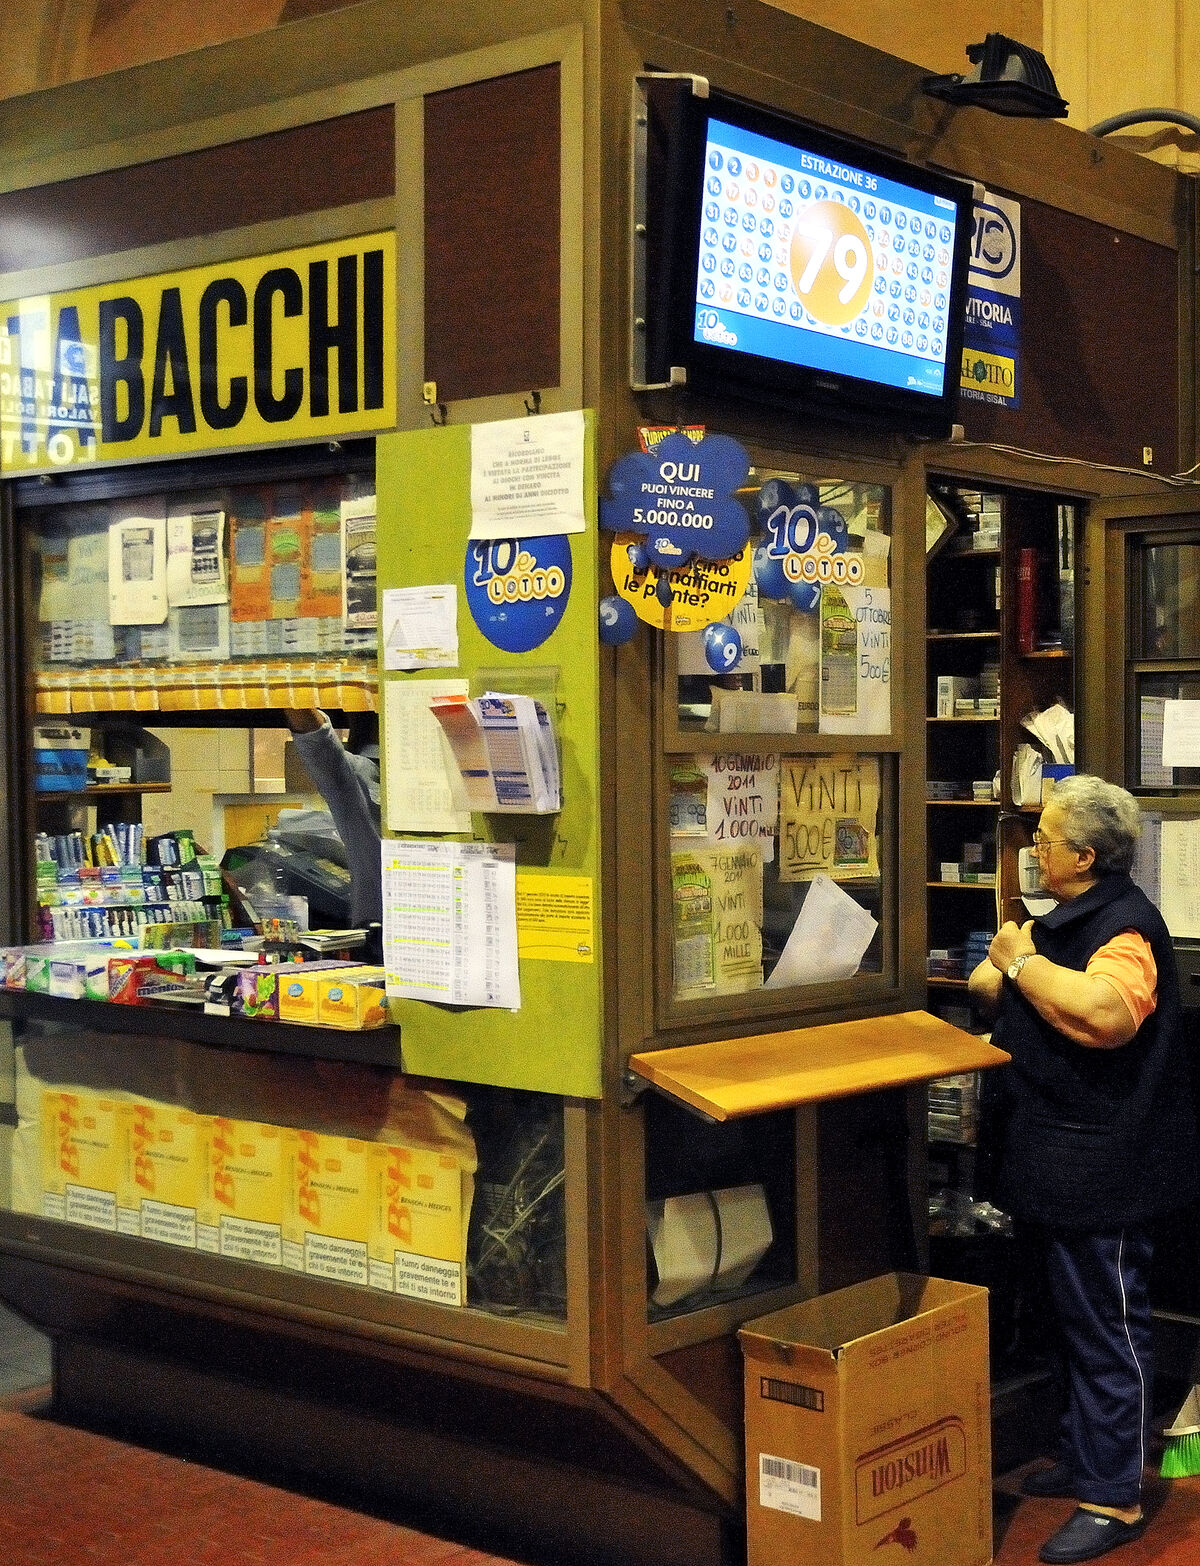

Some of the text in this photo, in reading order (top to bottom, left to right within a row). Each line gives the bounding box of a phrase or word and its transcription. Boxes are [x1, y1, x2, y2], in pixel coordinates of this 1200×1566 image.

[800, 154, 878, 191] ESTRAZIONE 36
[798, 227, 868, 304] 79
[7, 249, 385, 454] TABACCHI
[986, 394, 1008, 406] SISAL
[660, 462, 700, 484] QUI
[642, 482, 714, 499] PUOI VINCERE
[657, 498, 694, 511] FINO A
[632, 508, 713, 530] 5.000.000
[769, 508, 817, 556] 10
[476, 539, 516, 583] 10
[788, 556, 860, 580] LOTTO
[491, 573, 560, 599] LOTTO
[624, 574, 710, 608] le pnte?
[864, 588, 872, 606] 5
[723, 642, 738, 667] 9
[728, 774, 756, 790] 2011
[714, 818, 758, 840] 1.000
[400, 1196, 452, 1212] BENSON HEDGES
[400, 1270, 440, 1286] gravemente
[442, 1278, 449, 1286] te
[402, 1258, 460, 1278] fumo danneggia
[417, 1285, 428, 1294] sta
[430, 1286, 456, 1300] intorno
[870, 1436, 951, 1498] Winston
